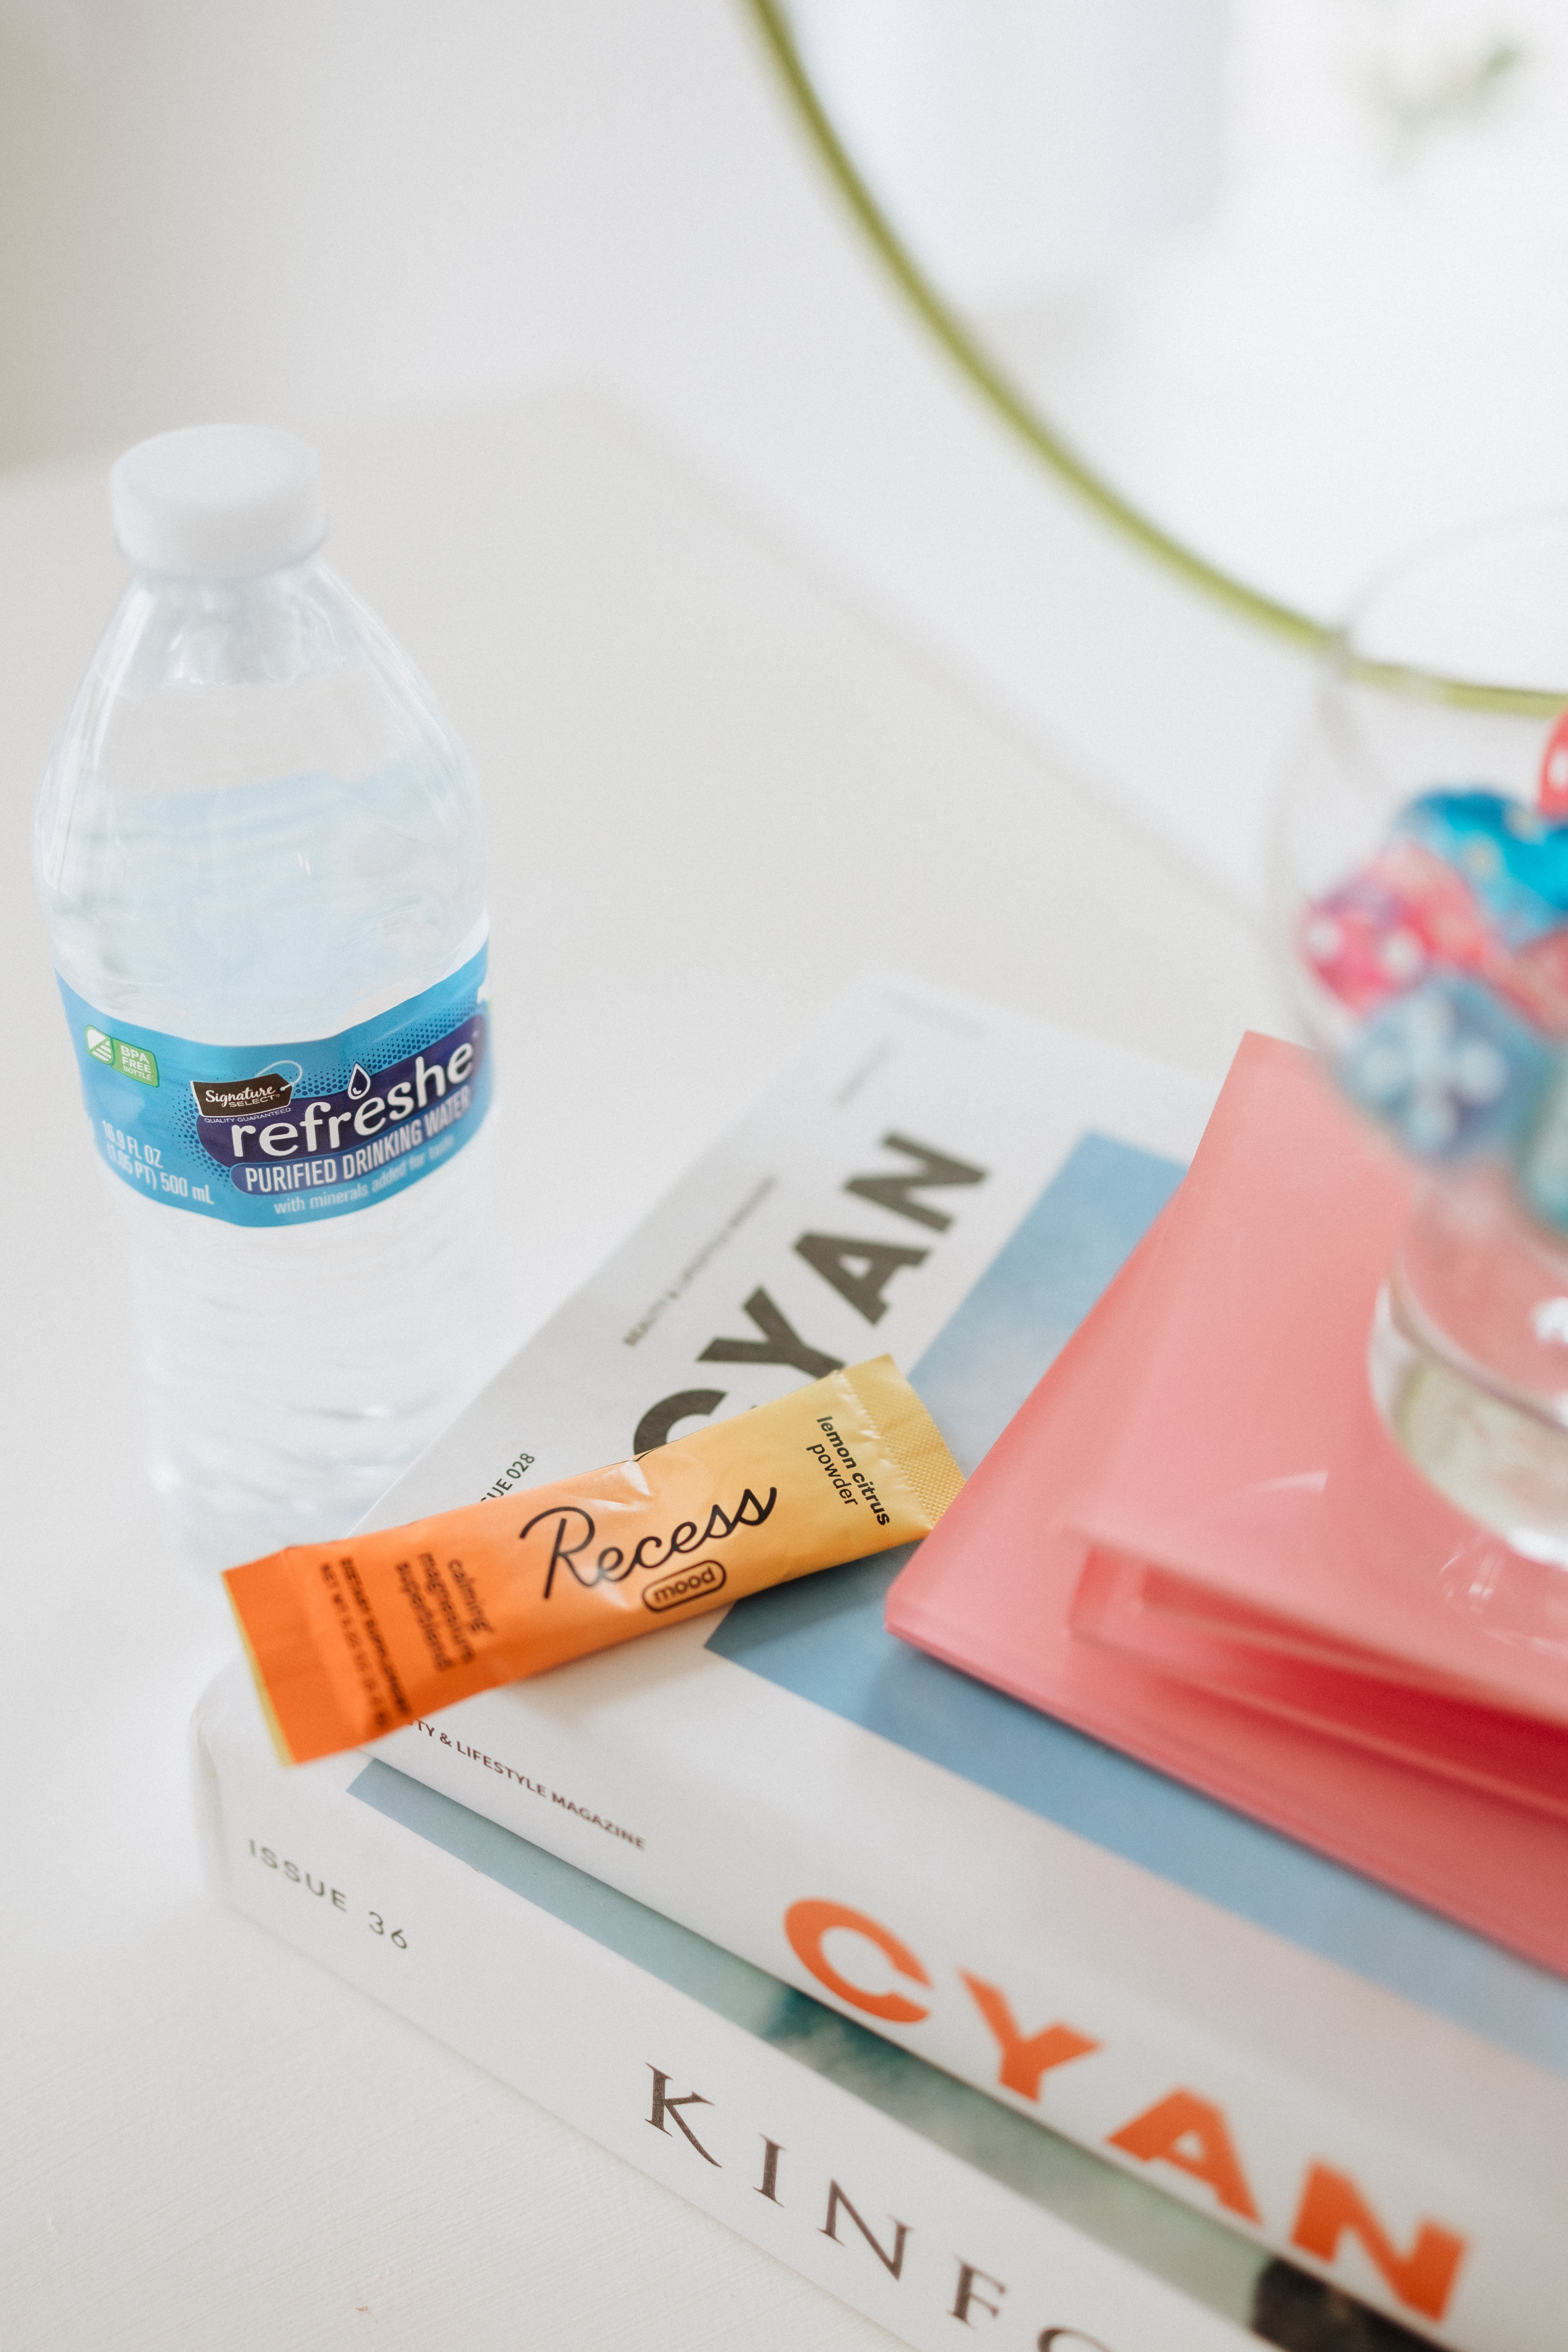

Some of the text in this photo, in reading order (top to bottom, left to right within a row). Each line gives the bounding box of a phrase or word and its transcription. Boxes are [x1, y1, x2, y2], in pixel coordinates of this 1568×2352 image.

[120, 1044, 150, 1064] BPA
[122, 1056, 152, 1074] FREE
[205, 1086, 276, 1108] Signature
[231, 1042, 473, 1157] refreshe
[237, 1107, 291, 1122] GUARANTEED
[102, 1119, 164, 1169] 16.9 FL OZ
[245, 1085, 471, 1192] PURIFIED DRINKING WATER
[134, 1160, 157, 1190] PT)
[159, 1172, 189, 1198] 500
[192, 1184, 215, 1205] mL
[274, 1196, 306, 1215] with
[310, 1182, 369, 1209] minerals
[506, 1453, 535, 1479] 028
[805, 1443, 859, 1505] powder
[816, 1415, 890, 1526] lemon citrus
[520, 1486, 777, 1600] Recess
[652, 1567, 717, 1604] mood
[439, 1732, 646, 1852] & LIFESTYLE MAGAZINE
[249, 1838, 408, 1950] ISSUE 36
[783, 1896, 1470, 2326] CYAN
